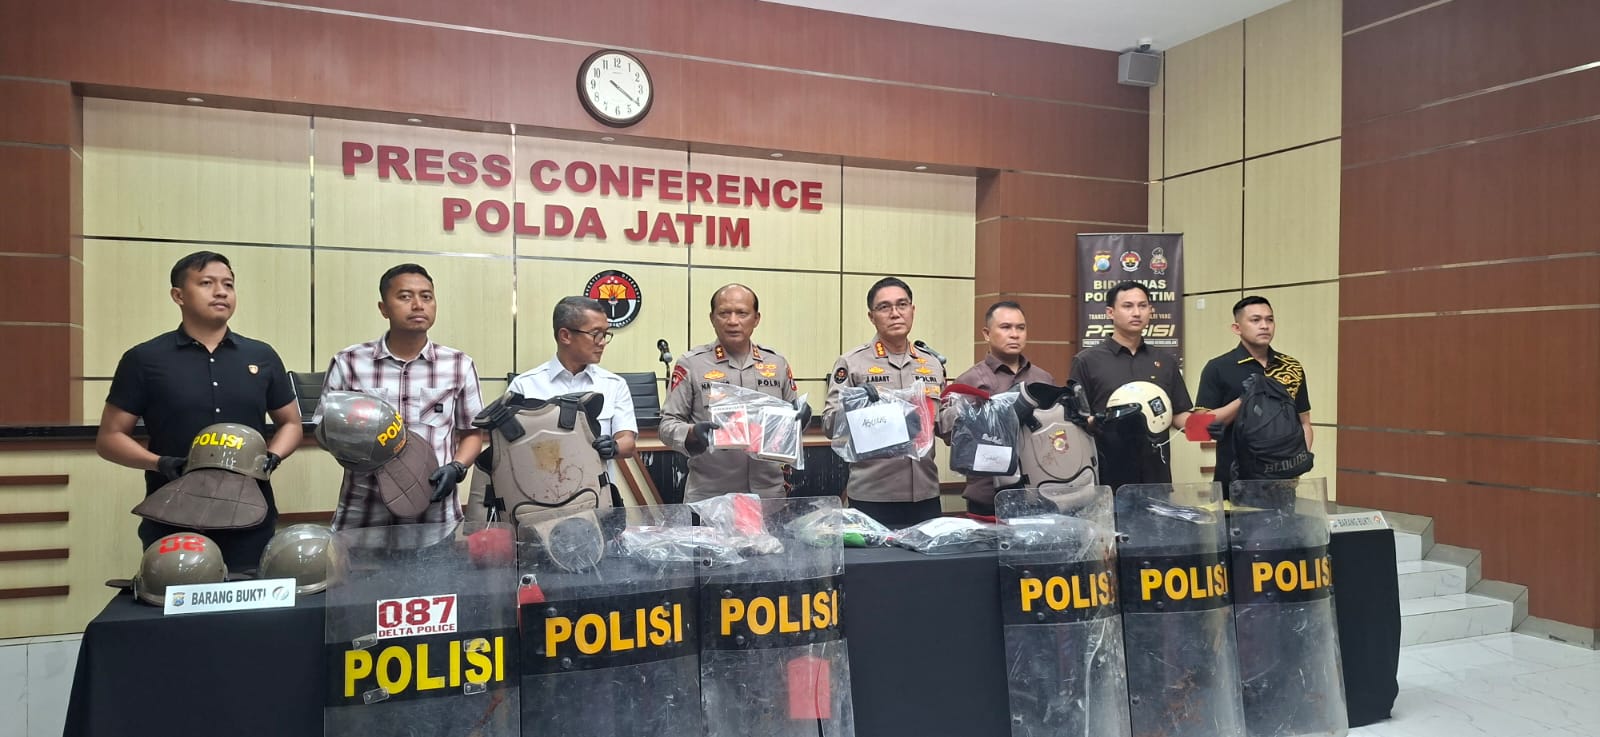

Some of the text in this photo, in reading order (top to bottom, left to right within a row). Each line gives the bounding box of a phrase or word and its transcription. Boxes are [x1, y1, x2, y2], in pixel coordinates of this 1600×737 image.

[342, 141, 823, 211] PRESS CONFERENCE
[443, 198, 750, 248] POLDA JATIM
[1094, 280, 1166, 289] BIDMAS
[192, 432, 243, 450] POLISI
[192, 588, 266, 605] BARANG BUKTI
[1020, 572, 1112, 612] POLIS
[378, 596, 455, 629] 087
[379, 623, 455, 637] DELTA POLICE
[545, 603, 683, 657] POLISI
[721, 590, 838, 635] POLISI
[344, 636, 504, 697] POLISI
